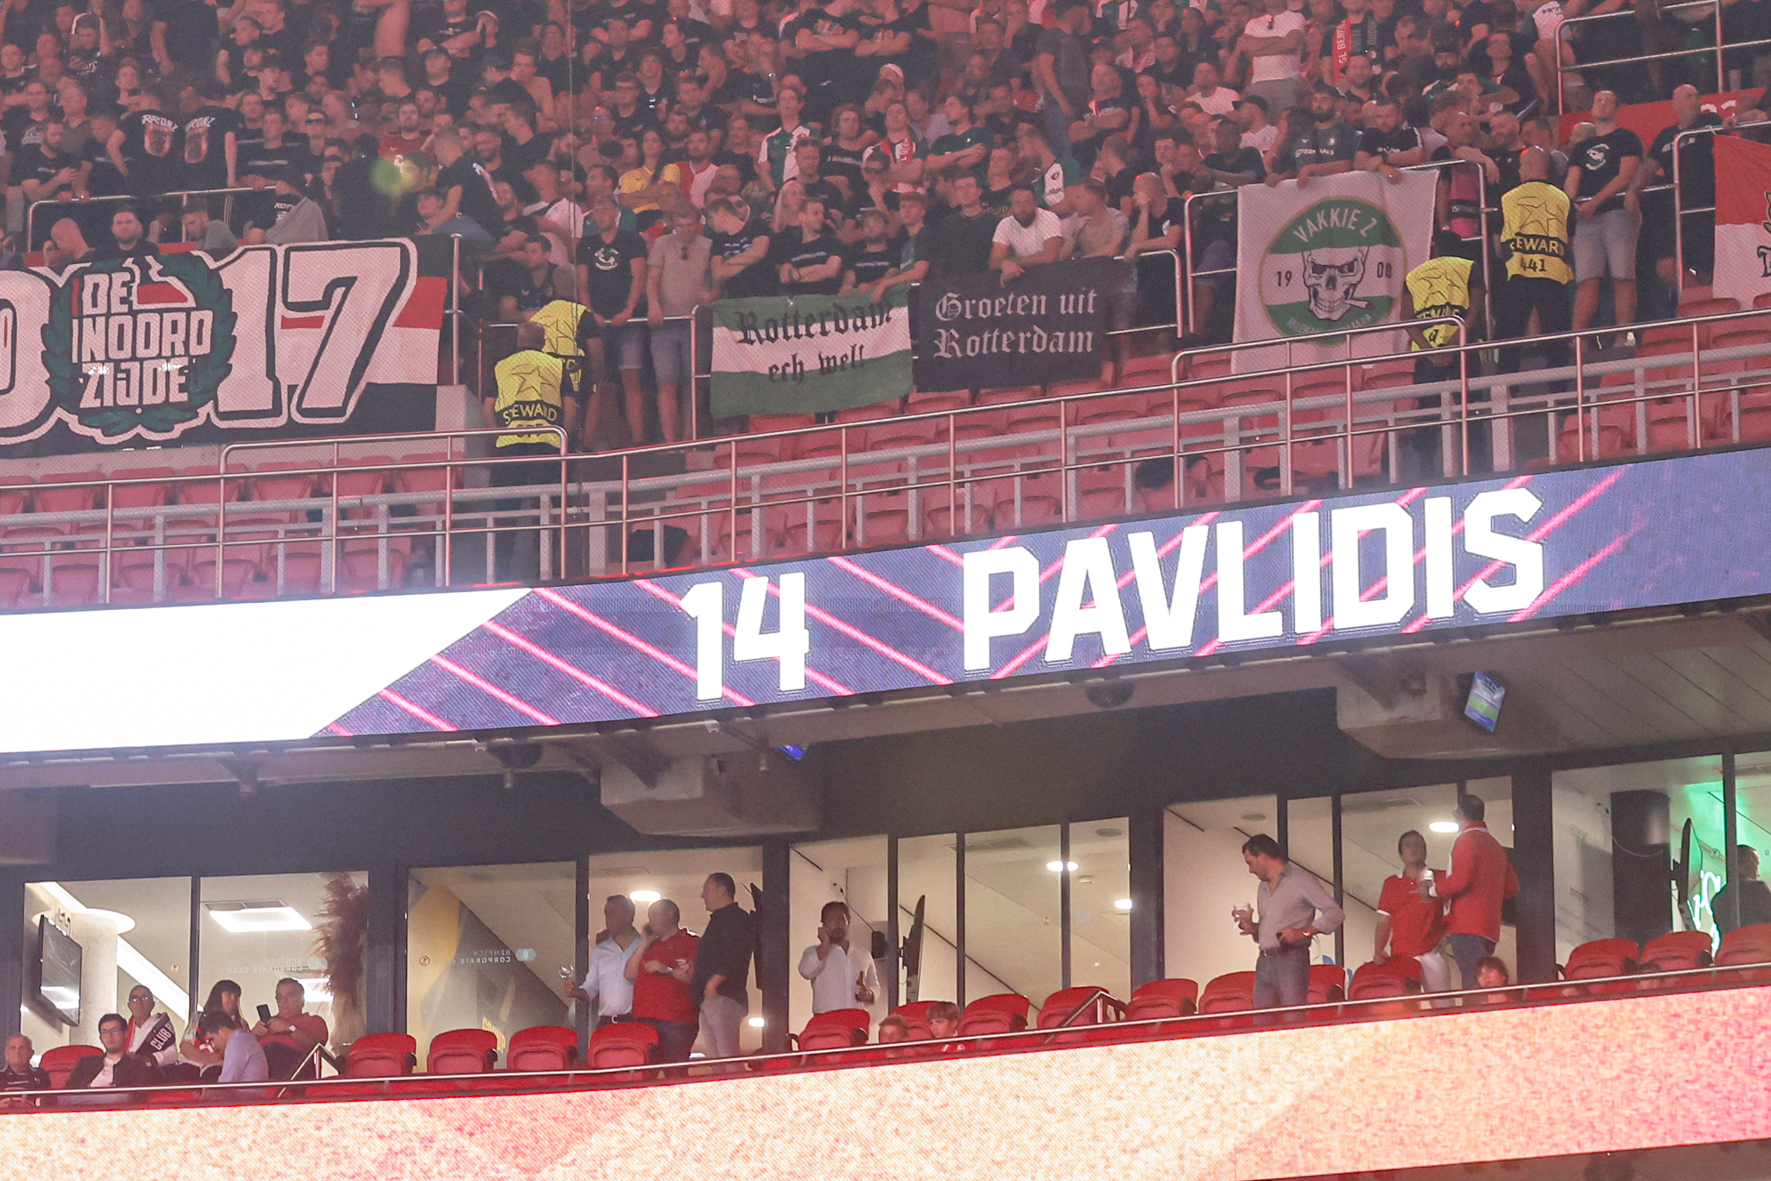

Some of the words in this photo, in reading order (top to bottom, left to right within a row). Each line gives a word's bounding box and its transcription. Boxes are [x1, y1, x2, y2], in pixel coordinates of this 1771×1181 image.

[1294, 207, 1361, 243] VAKKIE
[1360, 217, 1378, 238] Z
[1509, 237, 1564, 256] EWAR
[82, 271, 132, 316] DE
[1276, 270, 1293, 288] 19
[935, 291, 1047, 321] Groeten
[1059, 287, 1098, 315] uit
[81, 309, 214, 362] NOORD
[736, 300, 892, 346] Rotterdam
[933, 325, 1094, 359] Rotterdam
[679, 571, 810, 700] 14
[962, 487, 1543, 672] PAVLIDIS
